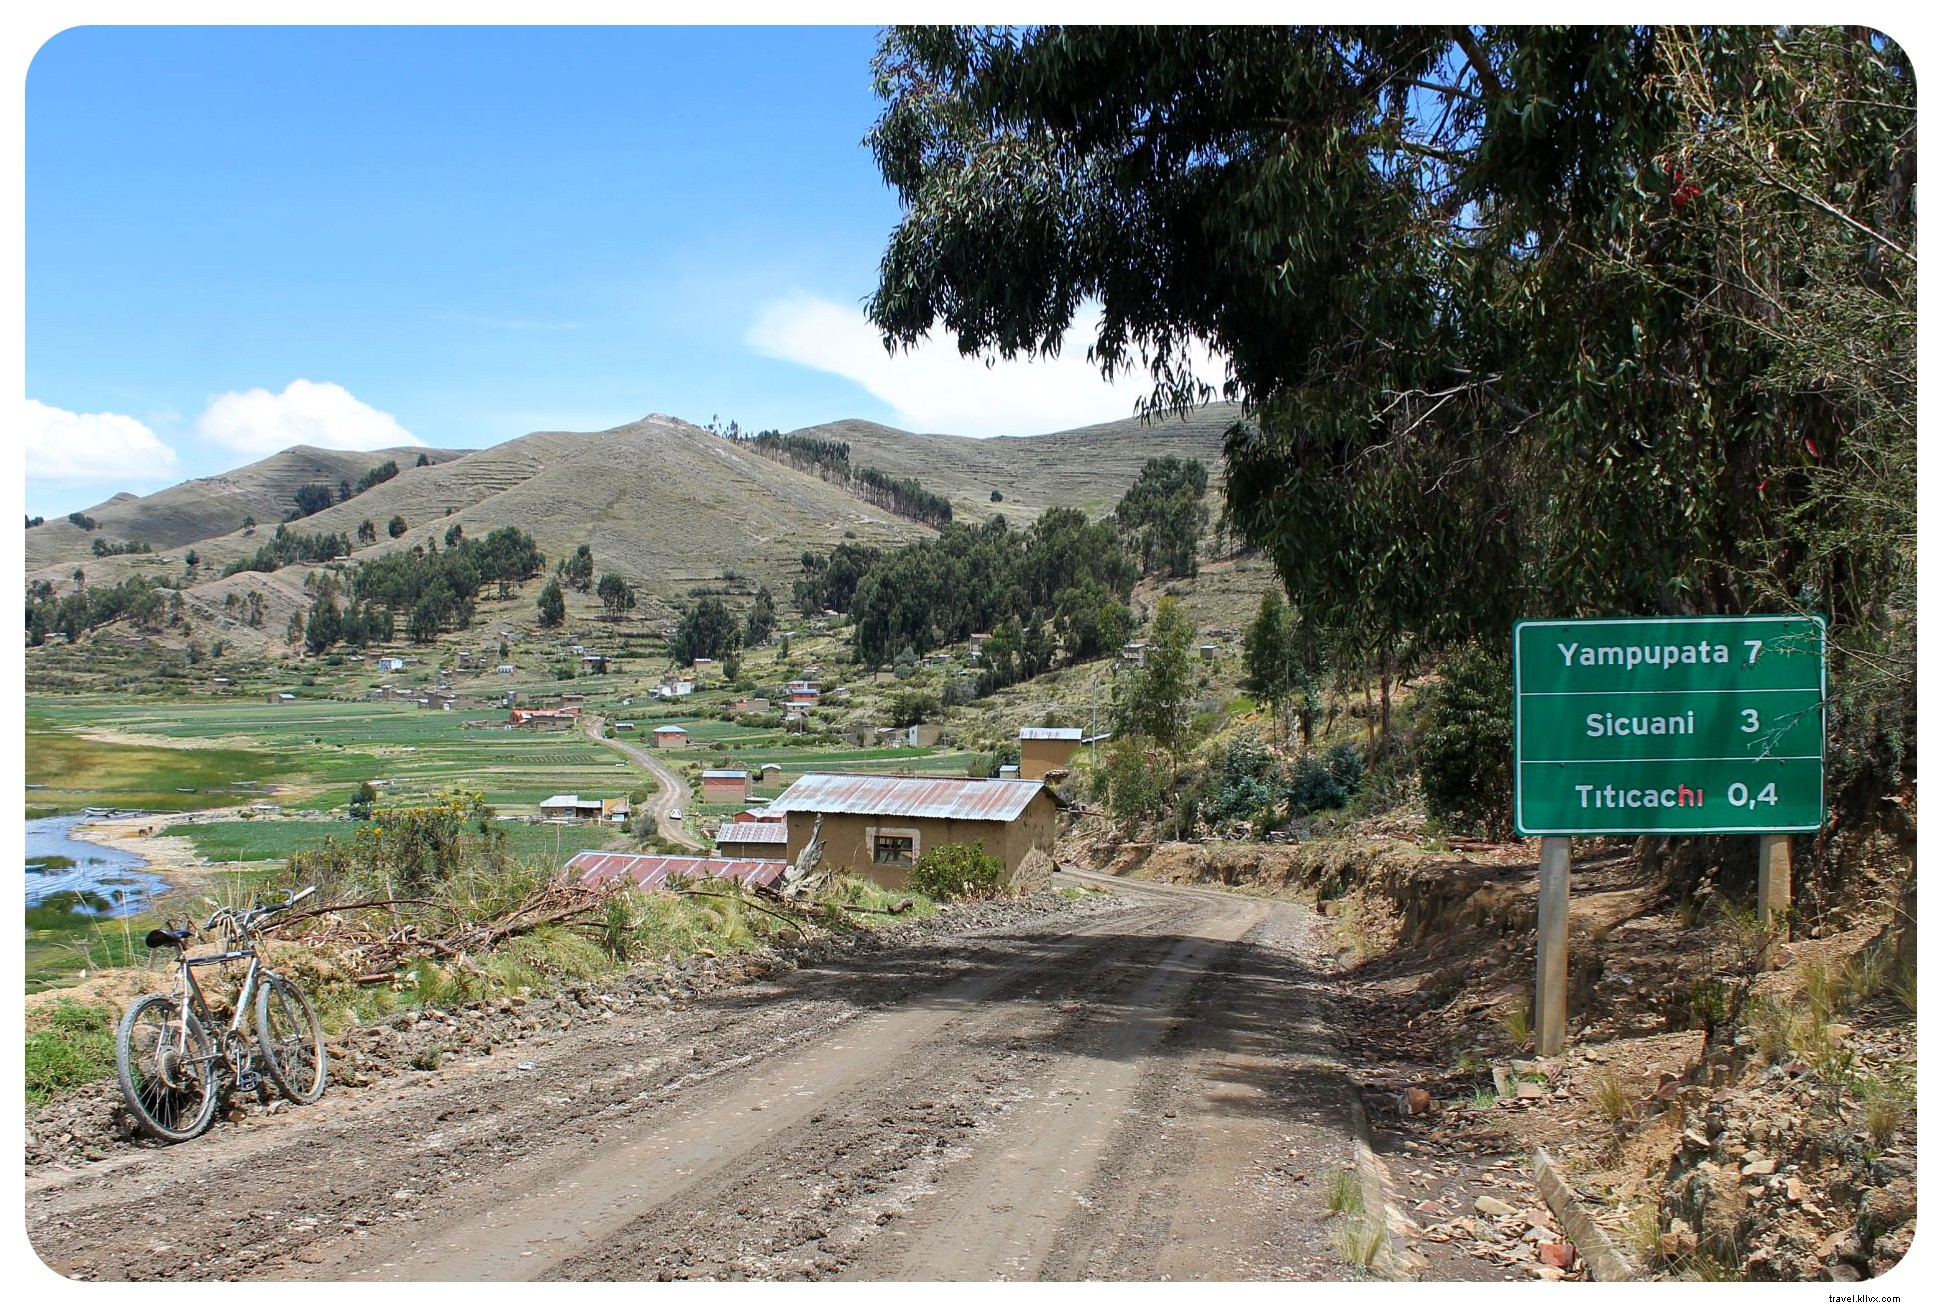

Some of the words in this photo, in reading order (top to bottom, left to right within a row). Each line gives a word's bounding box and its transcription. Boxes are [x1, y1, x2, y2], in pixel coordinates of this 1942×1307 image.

[1557, 641, 1729, 670] Yampupata
[1744, 640, 1762, 664] 7
[1586, 710, 1694, 737] Sicuani
[1740, 709, 1760, 733] 3
[1575, 783, 1703, 808] Titicachi
[1727, 782, 1778, 810] 0,4
